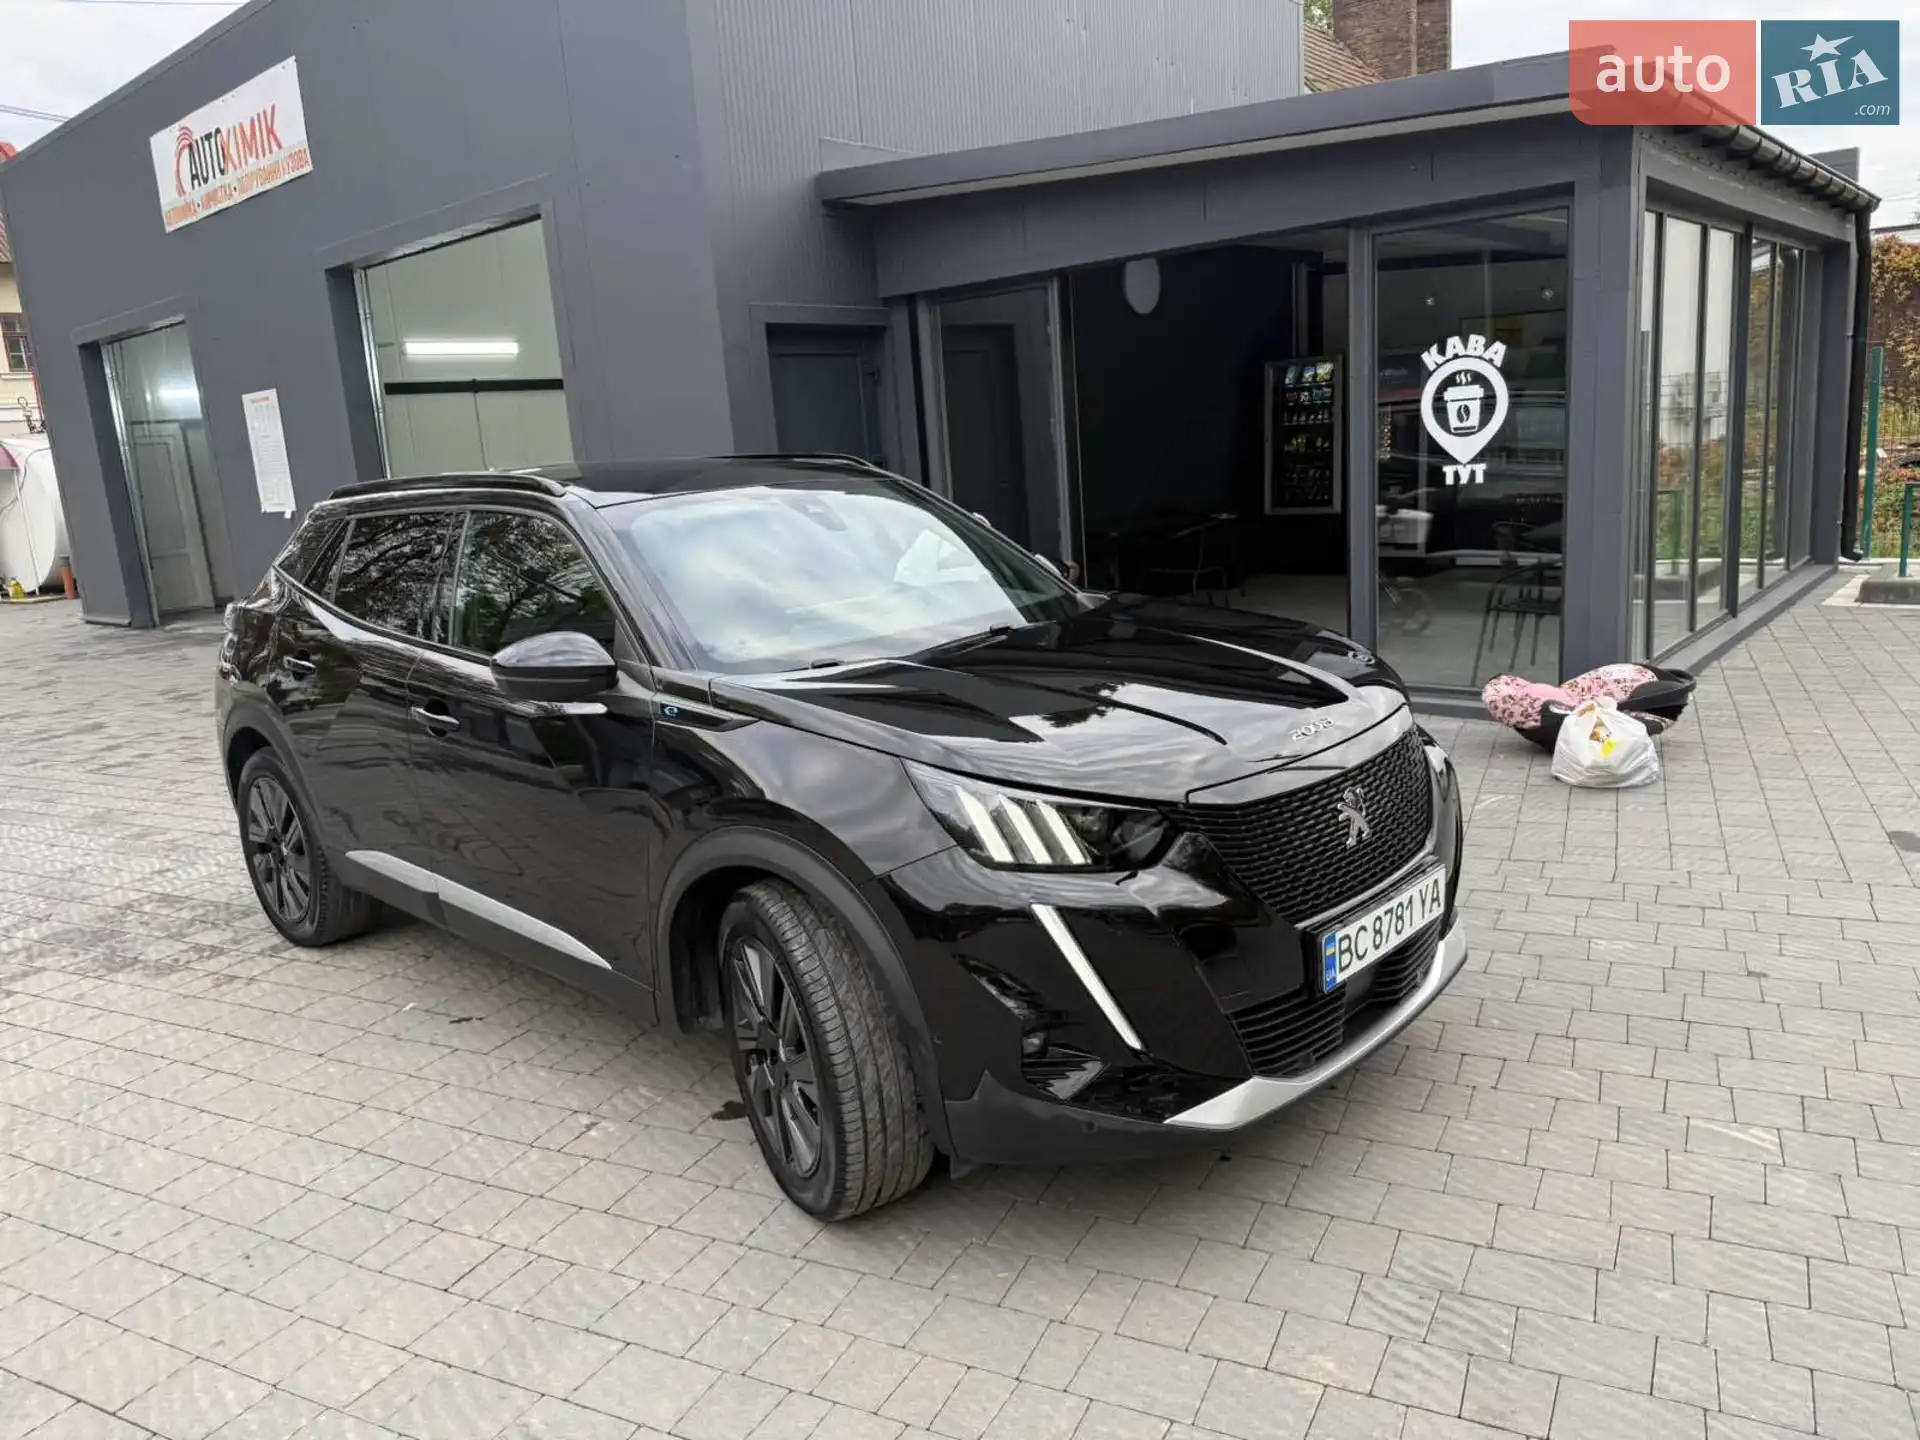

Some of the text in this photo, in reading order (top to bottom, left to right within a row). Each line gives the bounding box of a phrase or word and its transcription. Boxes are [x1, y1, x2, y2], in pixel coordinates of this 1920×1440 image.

[1420, 333, 1508, 372] КАВА
[1441, 463, 1488, 486] ТУТ
[1338, 878, 1442, 974] BC 8781 YA
